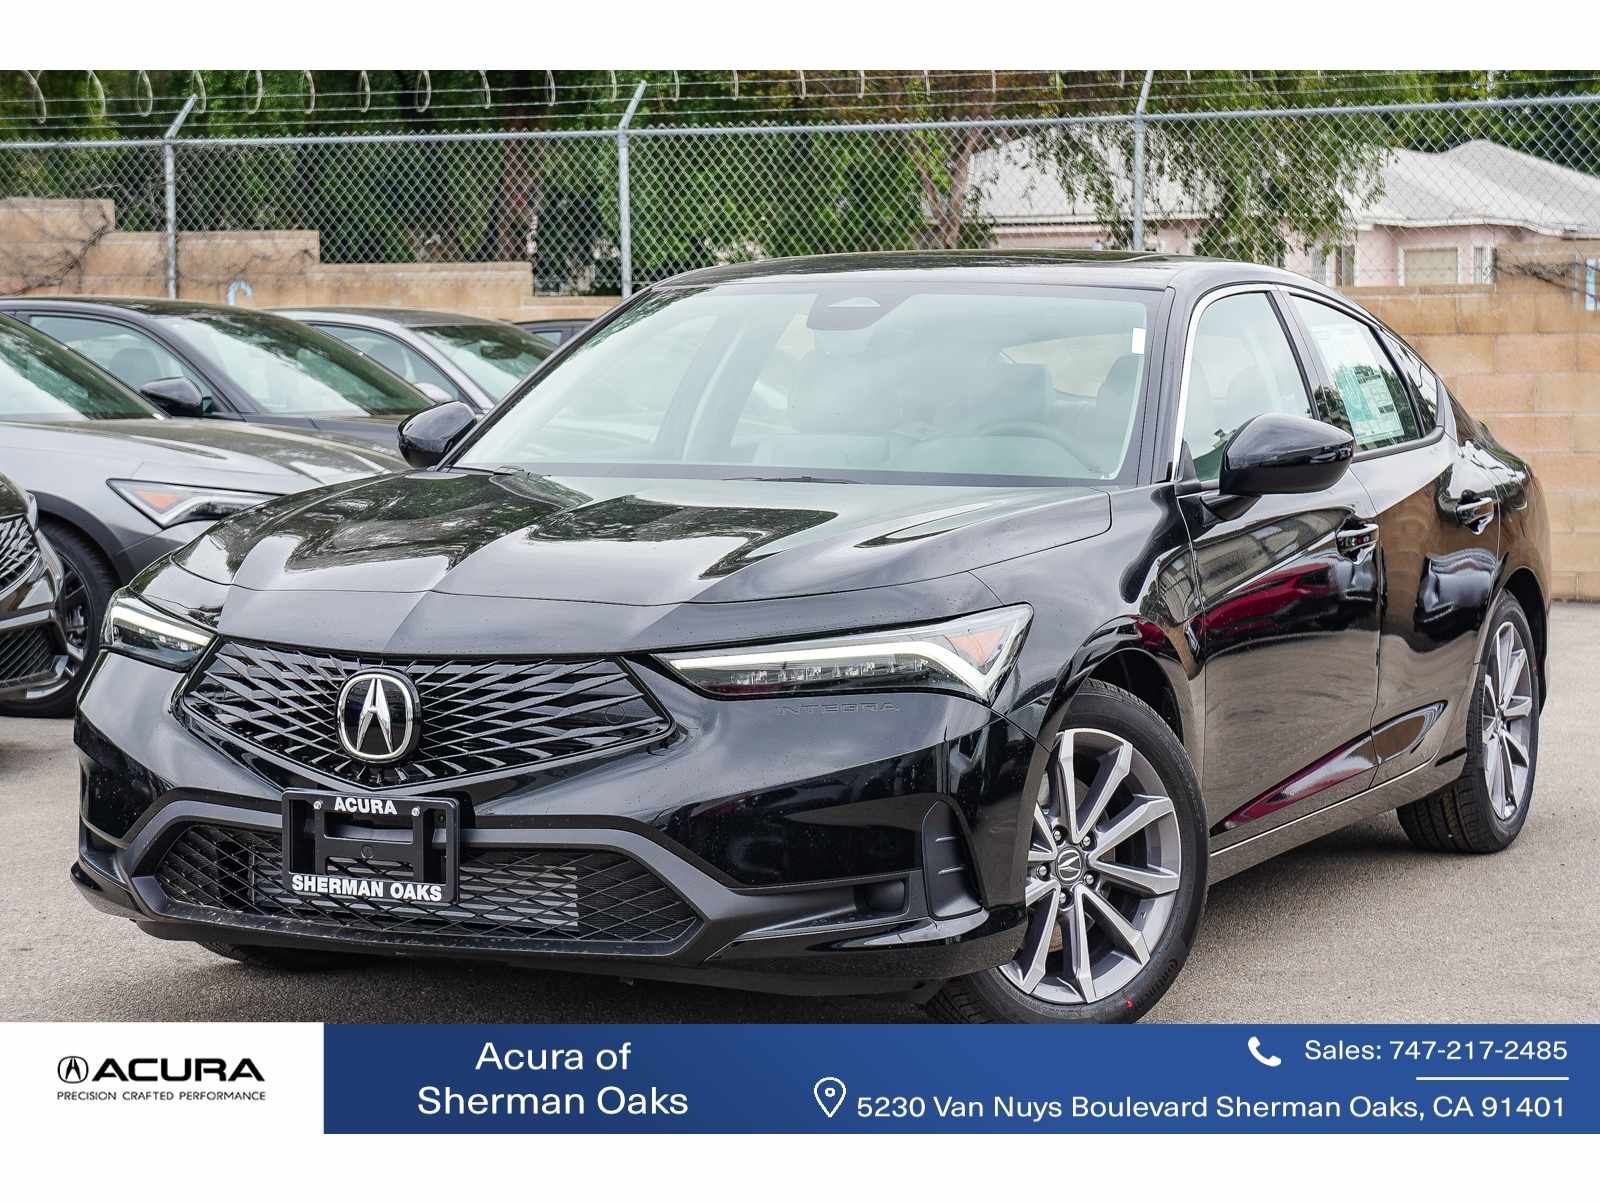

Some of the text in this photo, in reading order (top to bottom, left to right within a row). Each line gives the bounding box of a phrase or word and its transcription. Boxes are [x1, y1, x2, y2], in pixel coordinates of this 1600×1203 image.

[776, 702, 900, 717] INTEGRA
[334, 797, 398, 815] ACURA
[291, 874, 442, 902] SHERMAN OAKS
